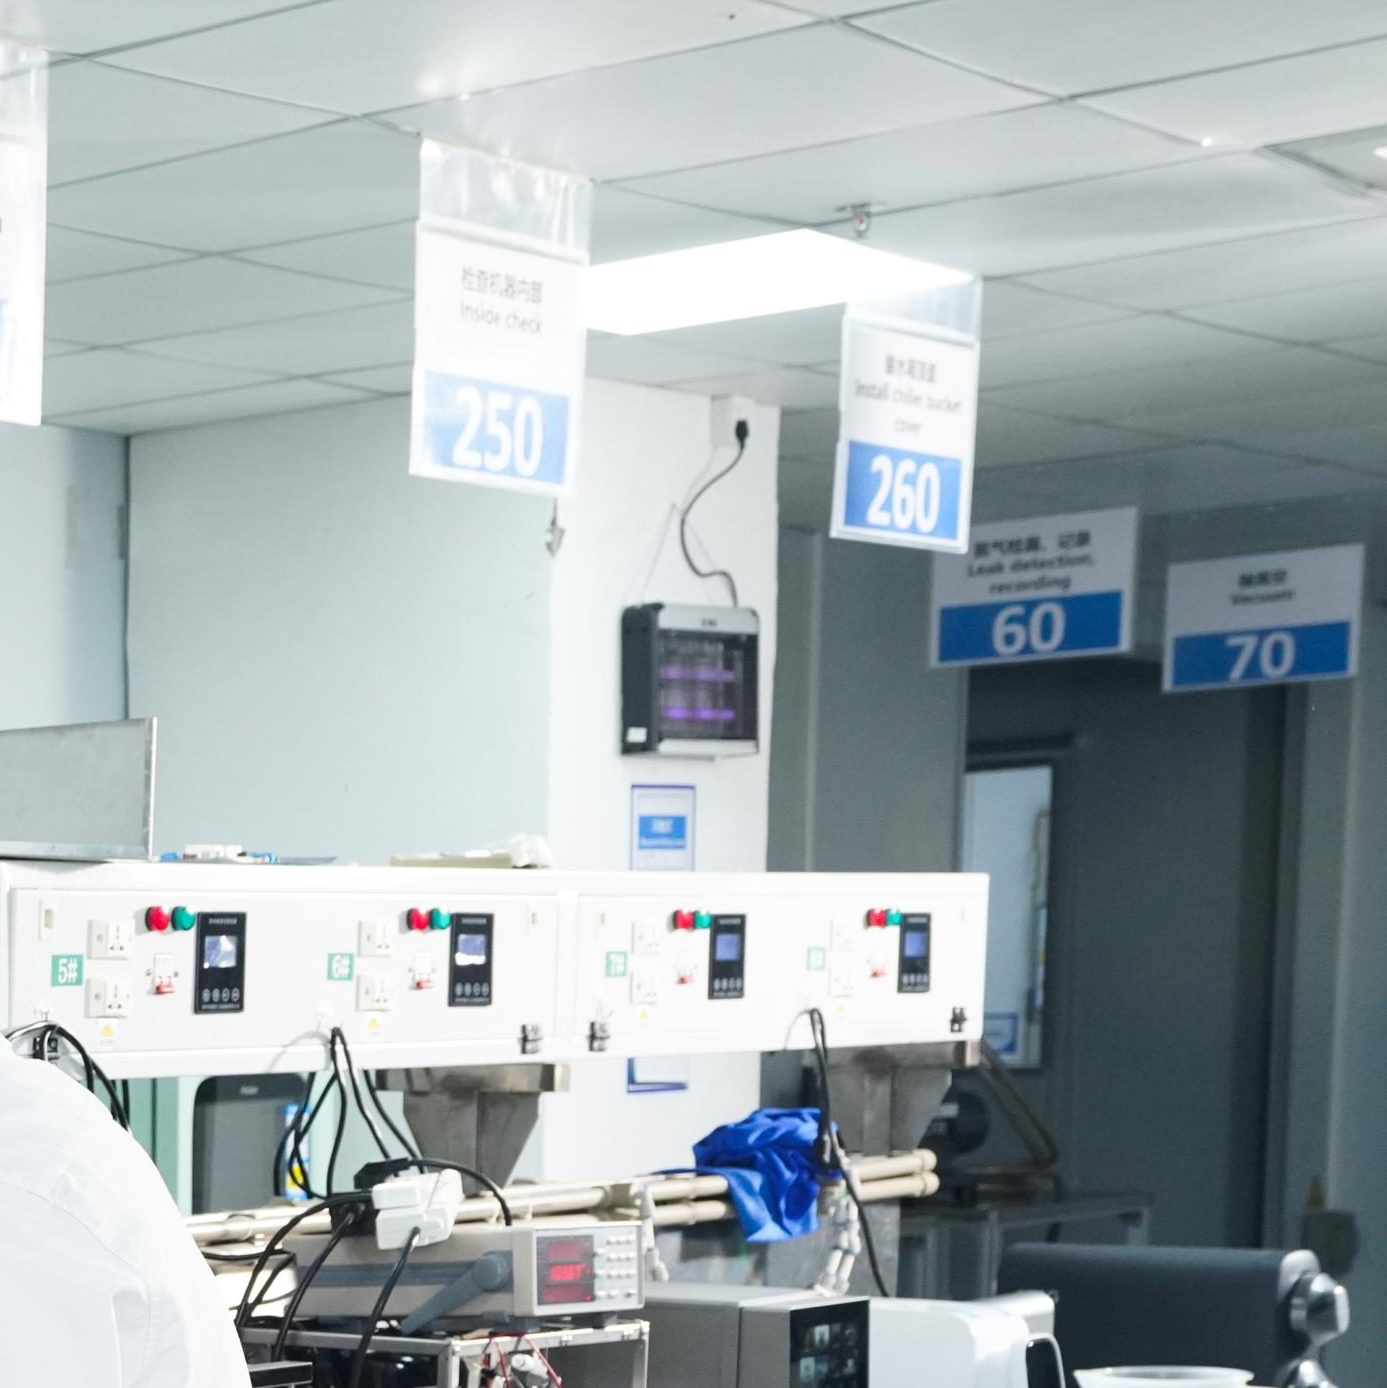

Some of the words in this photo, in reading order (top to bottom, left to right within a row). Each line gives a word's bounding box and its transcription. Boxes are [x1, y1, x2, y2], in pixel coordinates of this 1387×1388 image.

[452, 385, 544, 478] 250
[867, 453, 941, 534] 260
[992, 602, 1066, 656] 60
[1226, 630, 1296, 683] 70
[57, 959, 79, 984] 5#
